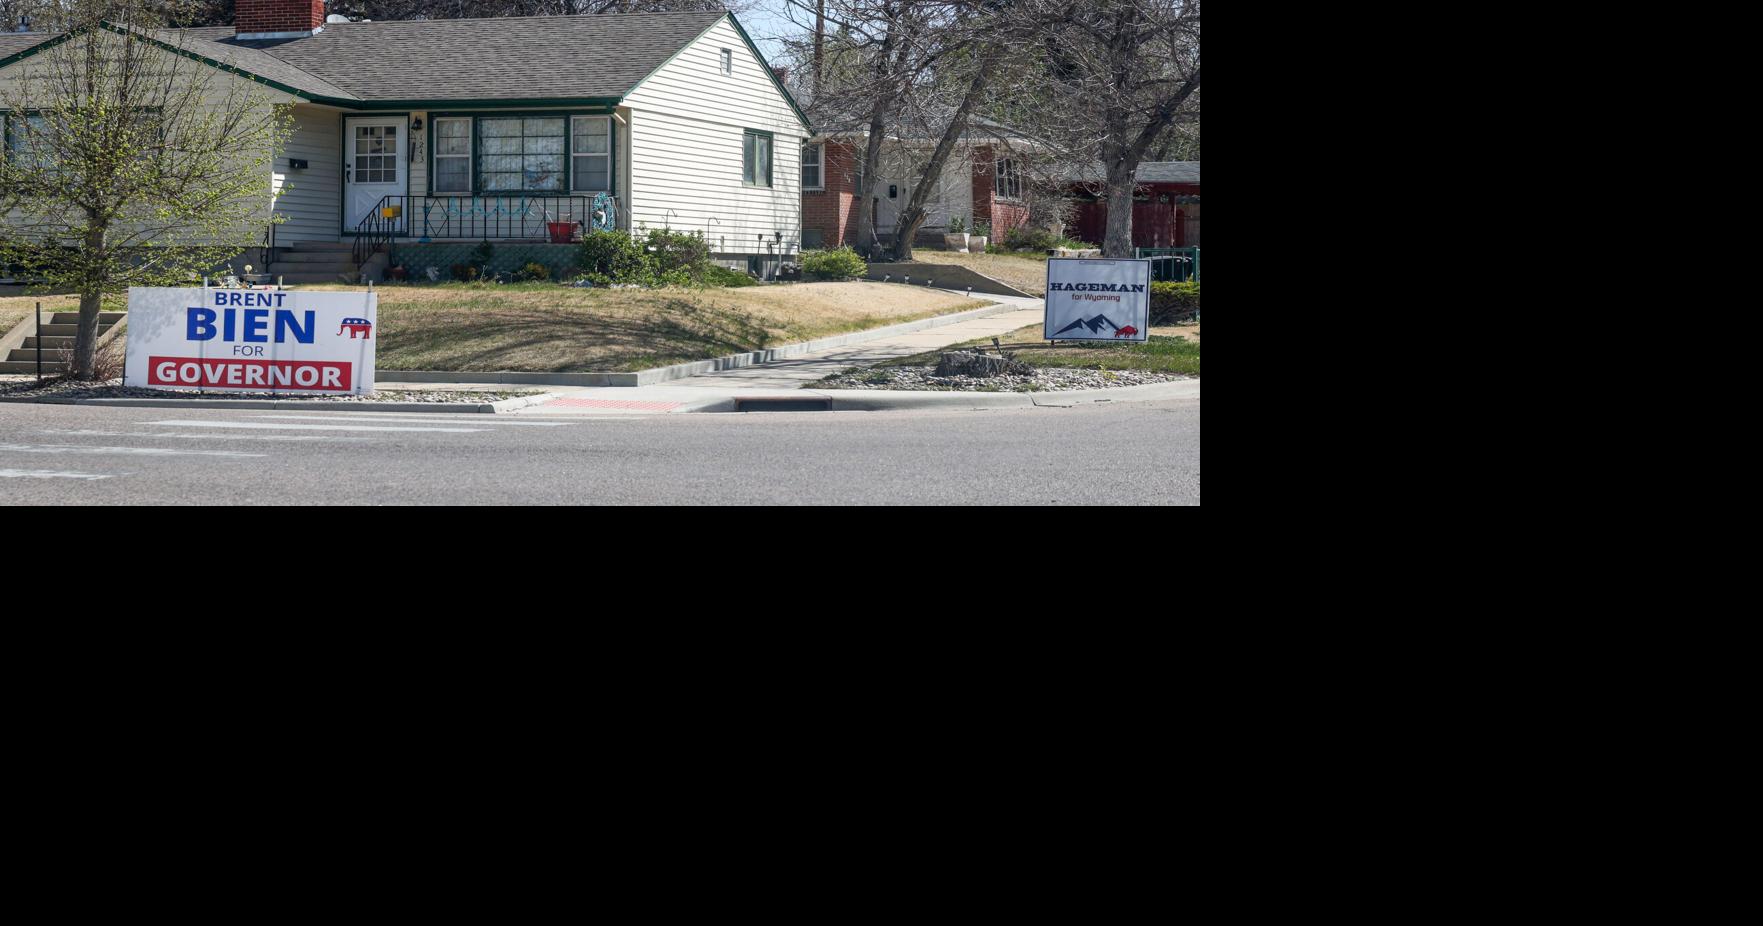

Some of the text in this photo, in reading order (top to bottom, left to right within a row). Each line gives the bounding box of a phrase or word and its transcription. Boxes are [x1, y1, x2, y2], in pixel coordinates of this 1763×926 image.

[1050, 282, 1145, 293] HAGEMAN
[215, 291, 286, 307] BRENT
[1084, 294, 1121, 303] Wyoming
[186, 307, 315, 344] BIEN
[233, 345, 264, 356] FOR
[156, 361, 342, 388] GOVERNOR
